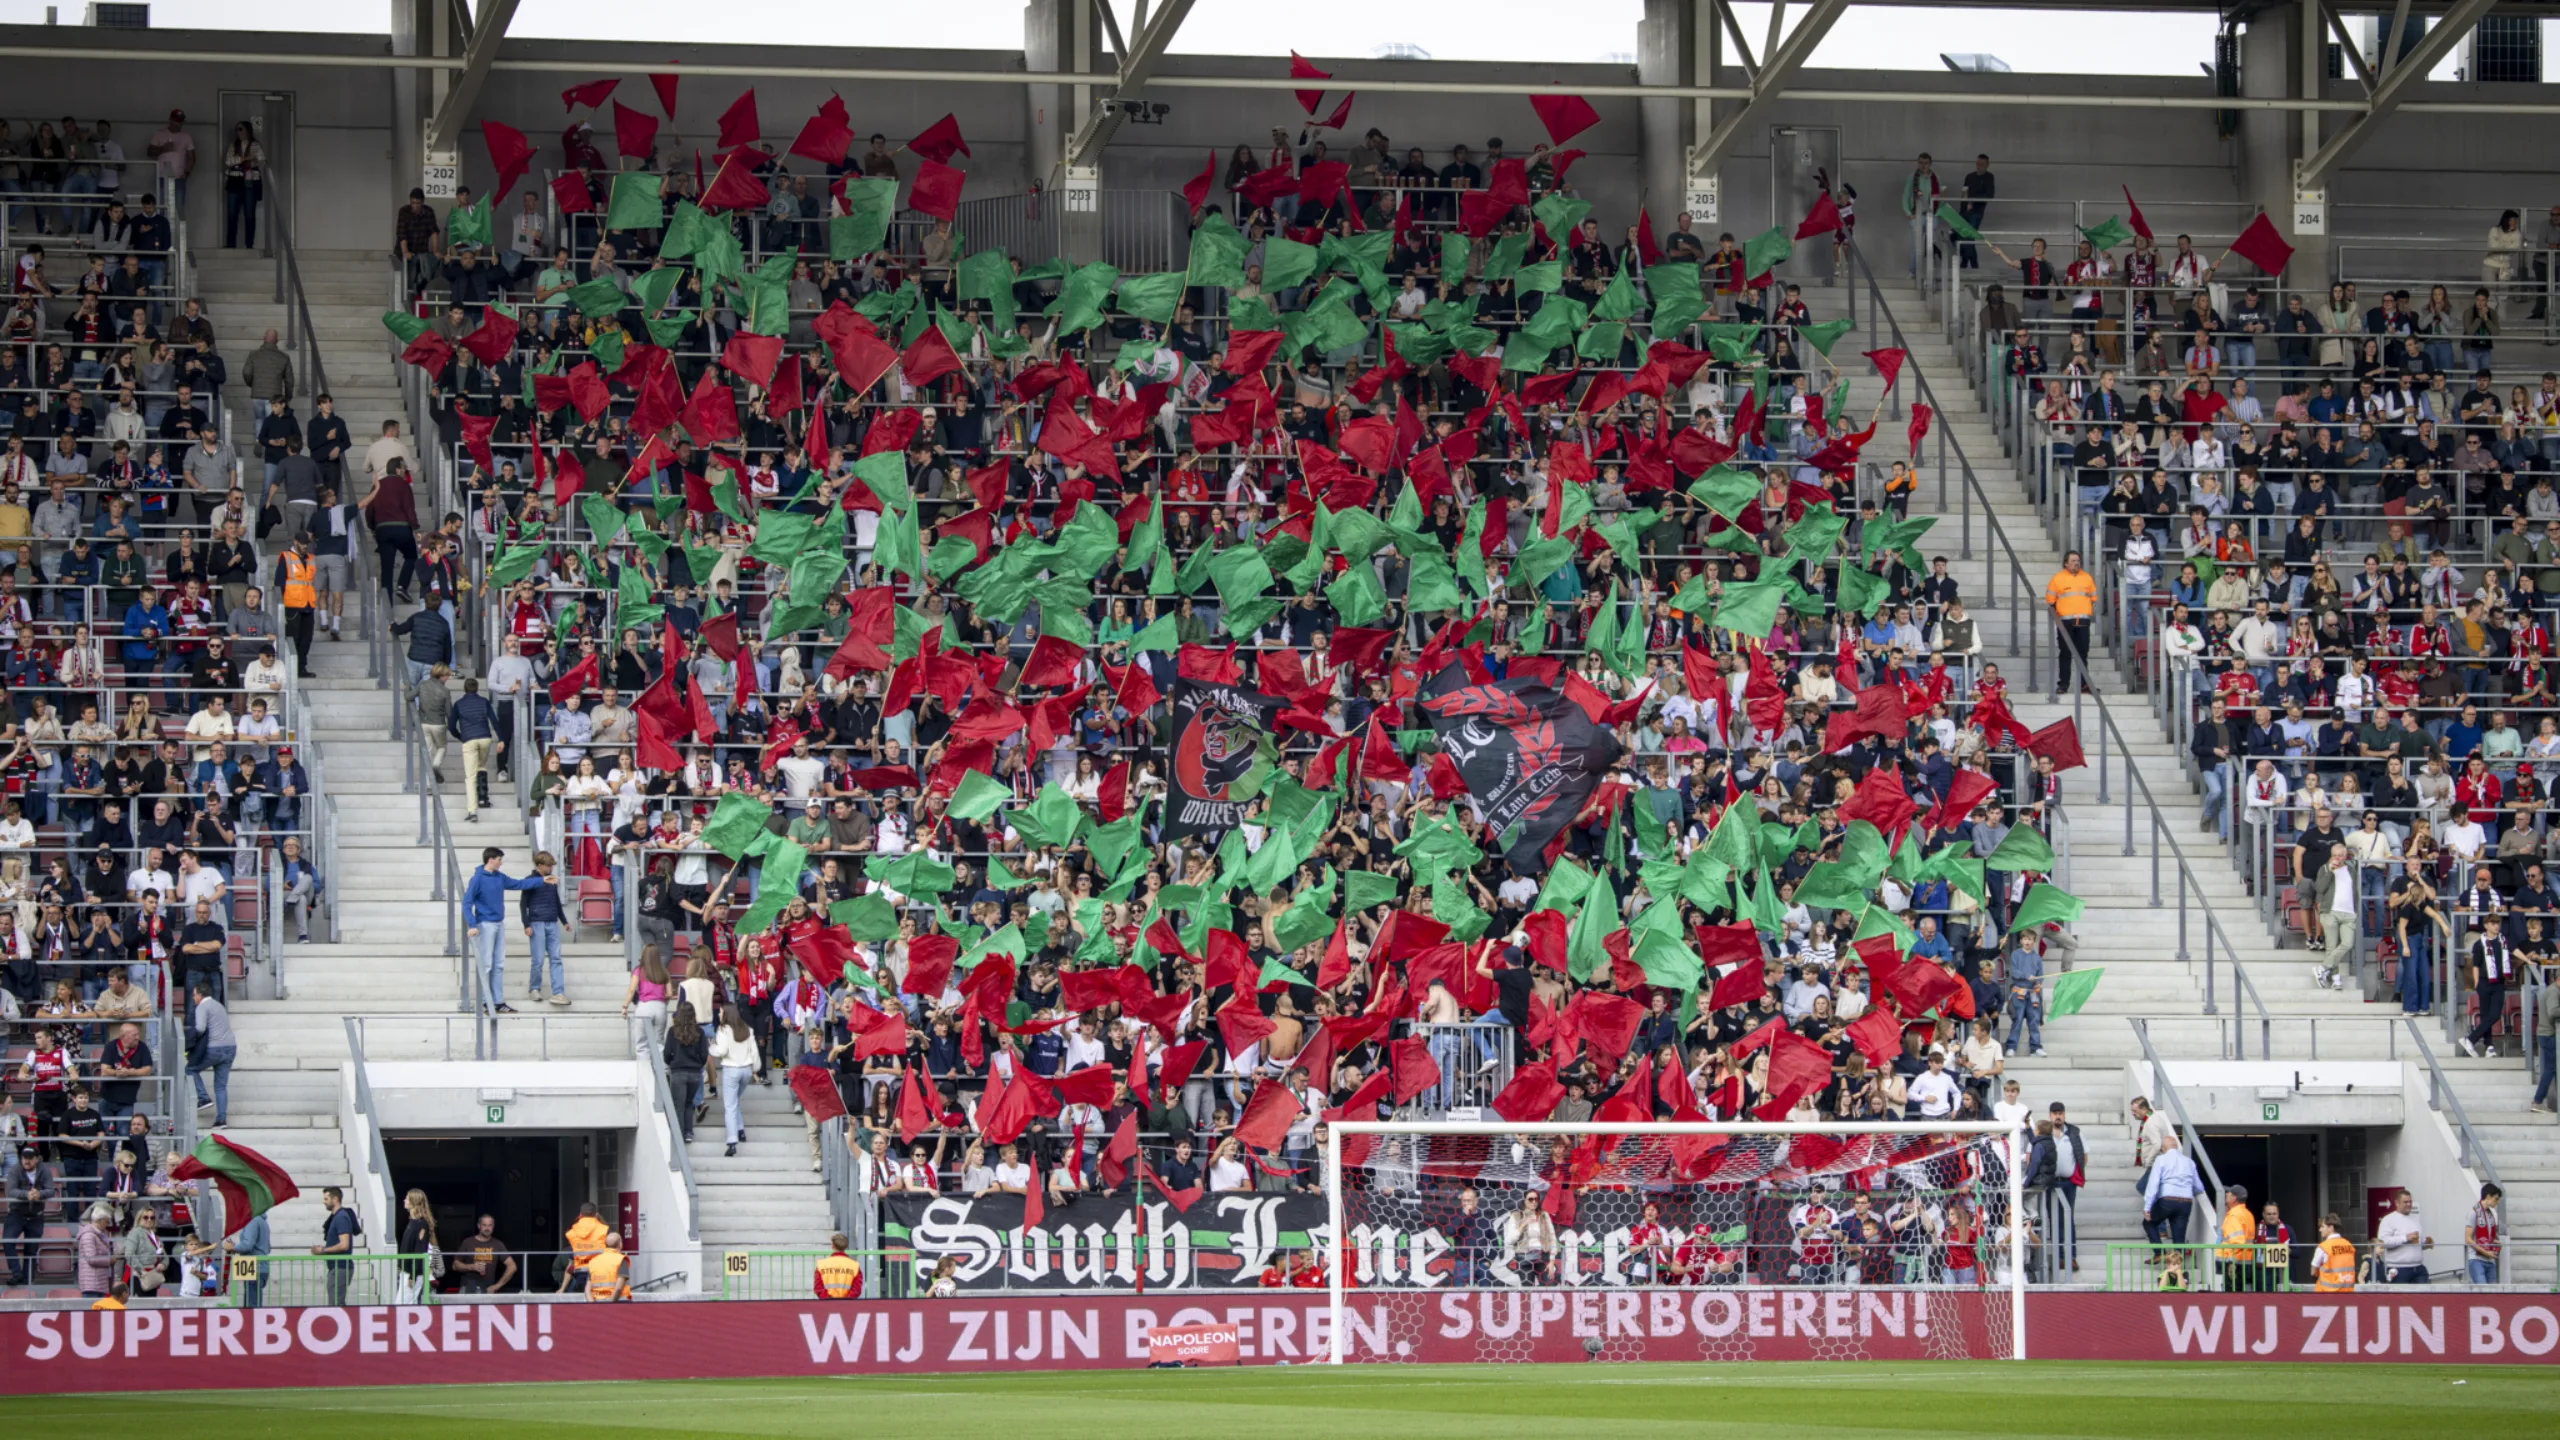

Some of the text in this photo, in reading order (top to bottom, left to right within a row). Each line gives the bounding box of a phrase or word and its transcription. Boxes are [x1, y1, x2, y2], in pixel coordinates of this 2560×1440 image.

[433, 168, 455, 178] 202
[425, 184, 447, 194] 203
[1069, 190, 1091, 200] 203
[1695, 194, 1715, 204] 203
[1689, 210, 1709, 220] 204
[2299, 214, 2319, 224] 204
[1498, 767, 1562, 820] Lane Crew
[911, 1197, 1190, 1290] South
[2267, 1248, 2287, 1264] 106
[234, 1260, 256, 1276] 104
[726, 1256, 747, 1272] 105
[821, 1266, 855, 1276] STEWARD
[1439, 1292, 1929, 1339] SUPERBOEREN!
[25, 1304, 554, 1361] SUPERBOEREN!
[799, 1312, 924, 1363] WIJ
[947, 1309, 1100, 1361] ZIJN
[2160, 1306, 2559, 1356] WIJ ZIJN BO
[1149, 1332, 1237, 1347] NAPOLEON
[1177, 1346, 1210, 1355] SCORE
